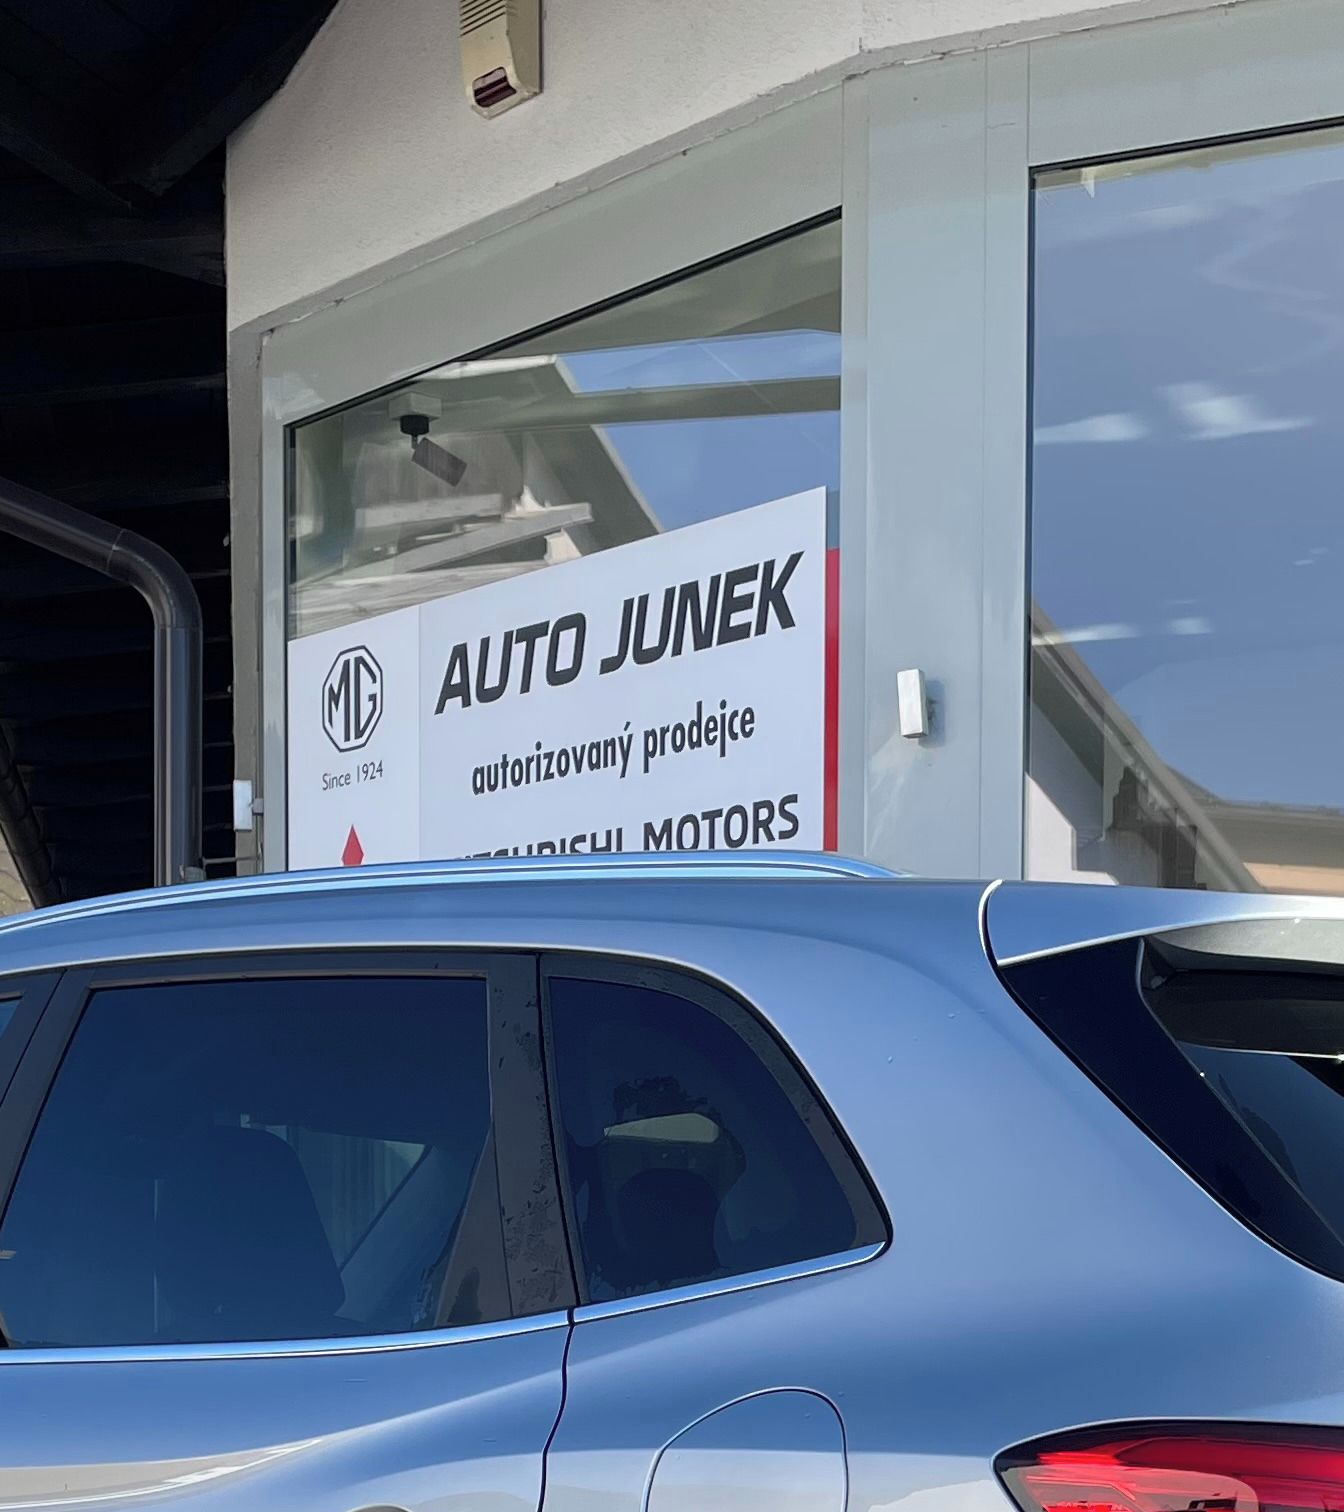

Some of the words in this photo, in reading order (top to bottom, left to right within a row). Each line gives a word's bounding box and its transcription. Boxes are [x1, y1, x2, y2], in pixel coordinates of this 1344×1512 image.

[434, 612, 587, 715] AUTO
[599, 551, 805, 675] JUNEK
[326, 652, 379, 744] MG
[321, 772, 352, 791] Since
[356, 760, 384, 783] 1924
[472, 721, 633, 795] autorizovaný
[642, 699, 756, 773] prodejce
[642, 794, 800, 852] MOTORS
